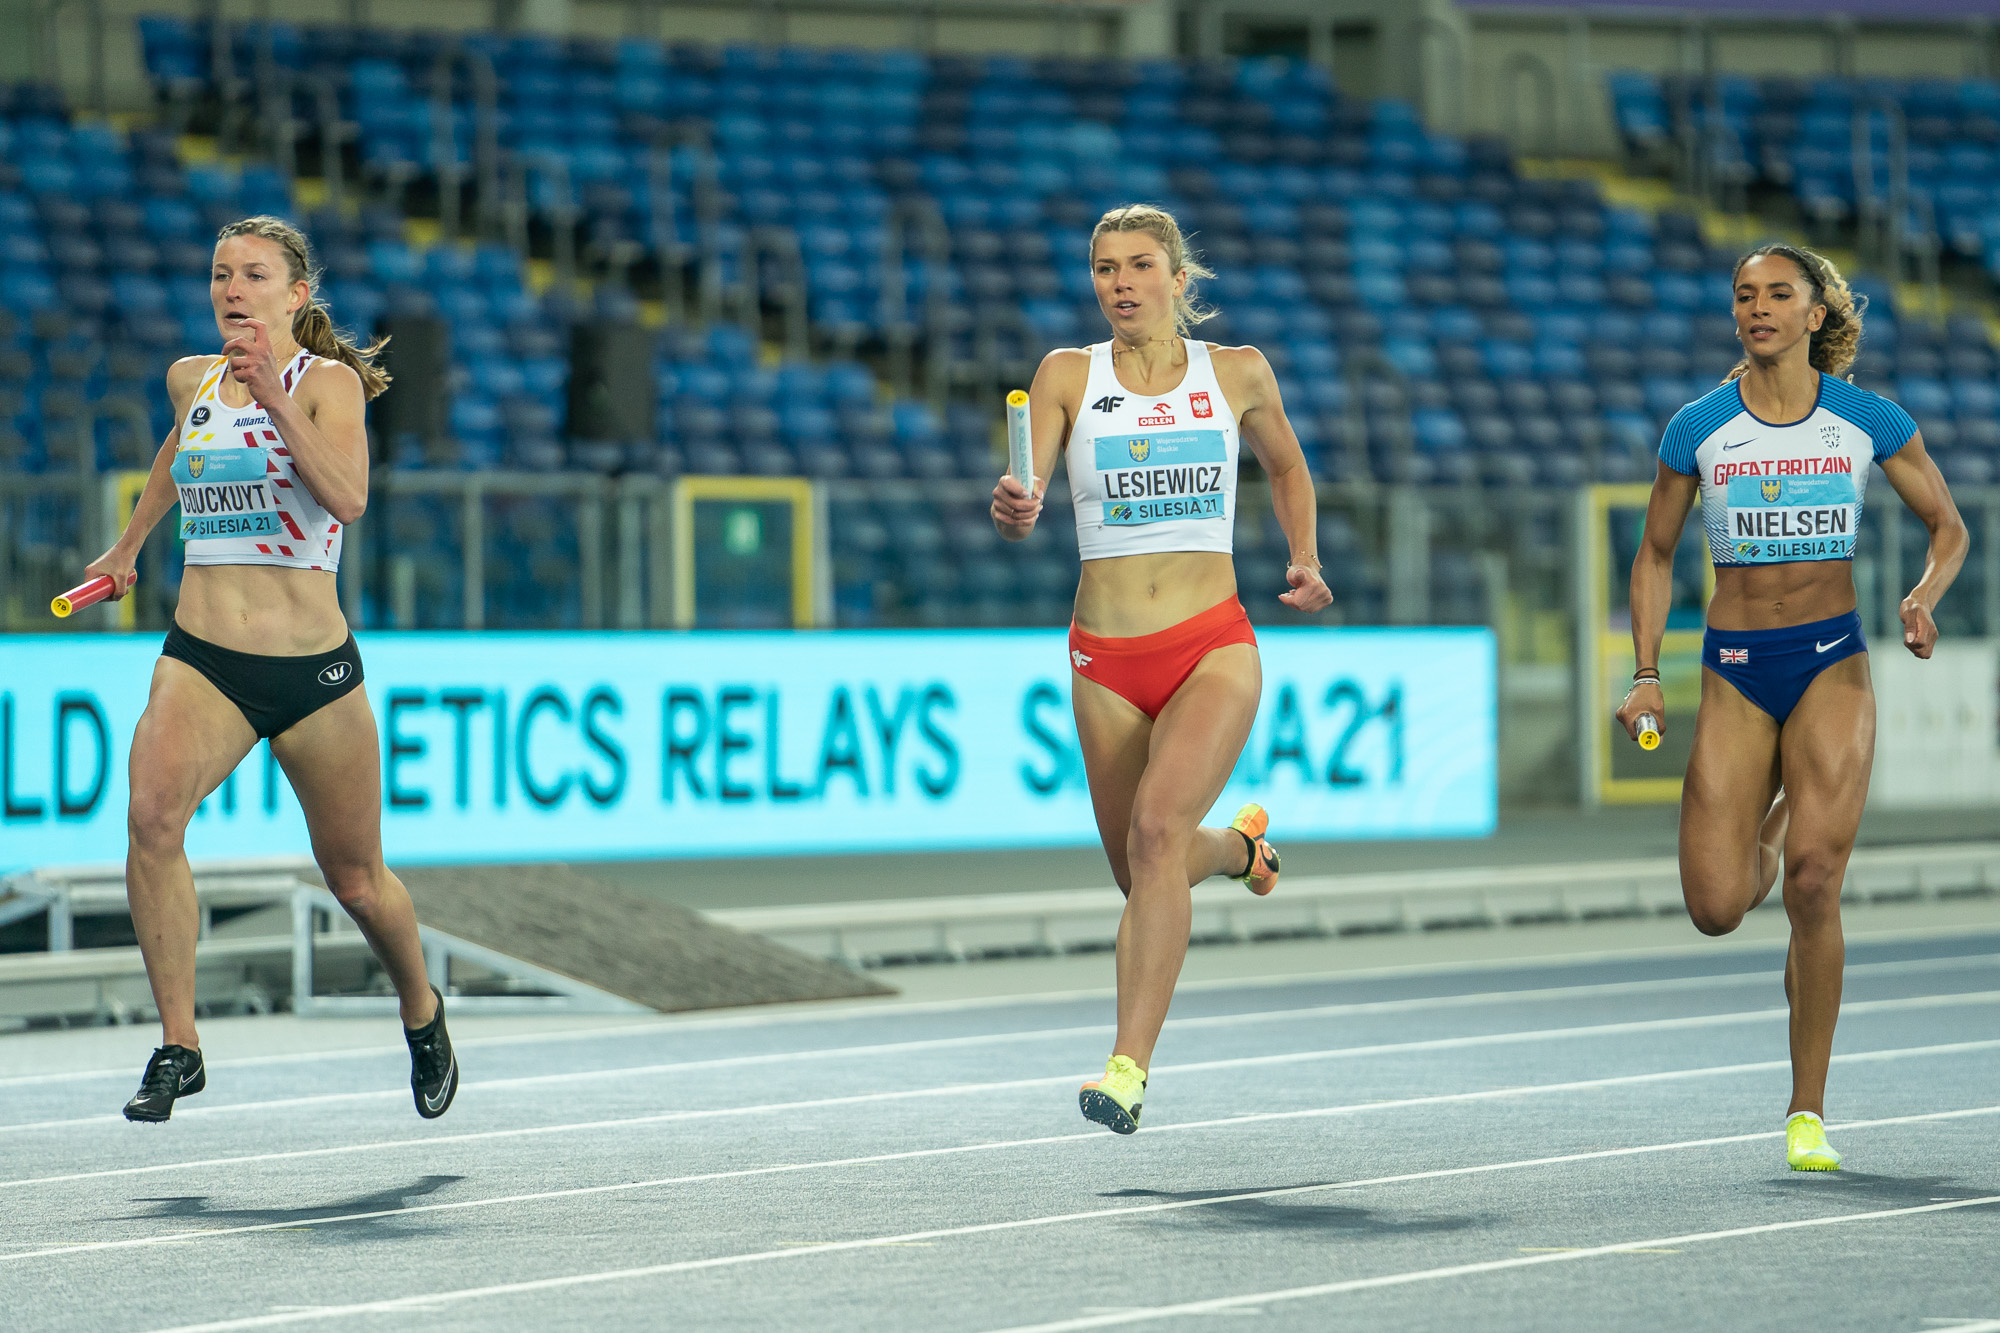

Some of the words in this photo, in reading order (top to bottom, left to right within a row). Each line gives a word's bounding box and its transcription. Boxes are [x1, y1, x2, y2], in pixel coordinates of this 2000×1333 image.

[1091, 396, 1125, 412] 4F
[233, 416, 266, 428] Allianz
[1139, 417, 1174, 426] ORLEN
[1777, 456, 1852, 476] BRITAIN
[1104, 466, 1222, 499] LESIEWICZ
[181, 485, 266, 513] COUCKUYT
[1139, 500, 1202, 519] SILESIA
[1205, 498, 1217, 513] 21
[199, 517, 252, 536] SILESIA
[256, 516, 271, 531] 21
[1736, 508, 1847, 537] NIELSEN
[1767, 540, 1826, 557] SILESIA
[1829, 539, 1846, 554] 21
[660, 680, 961, 804] RELAYS
